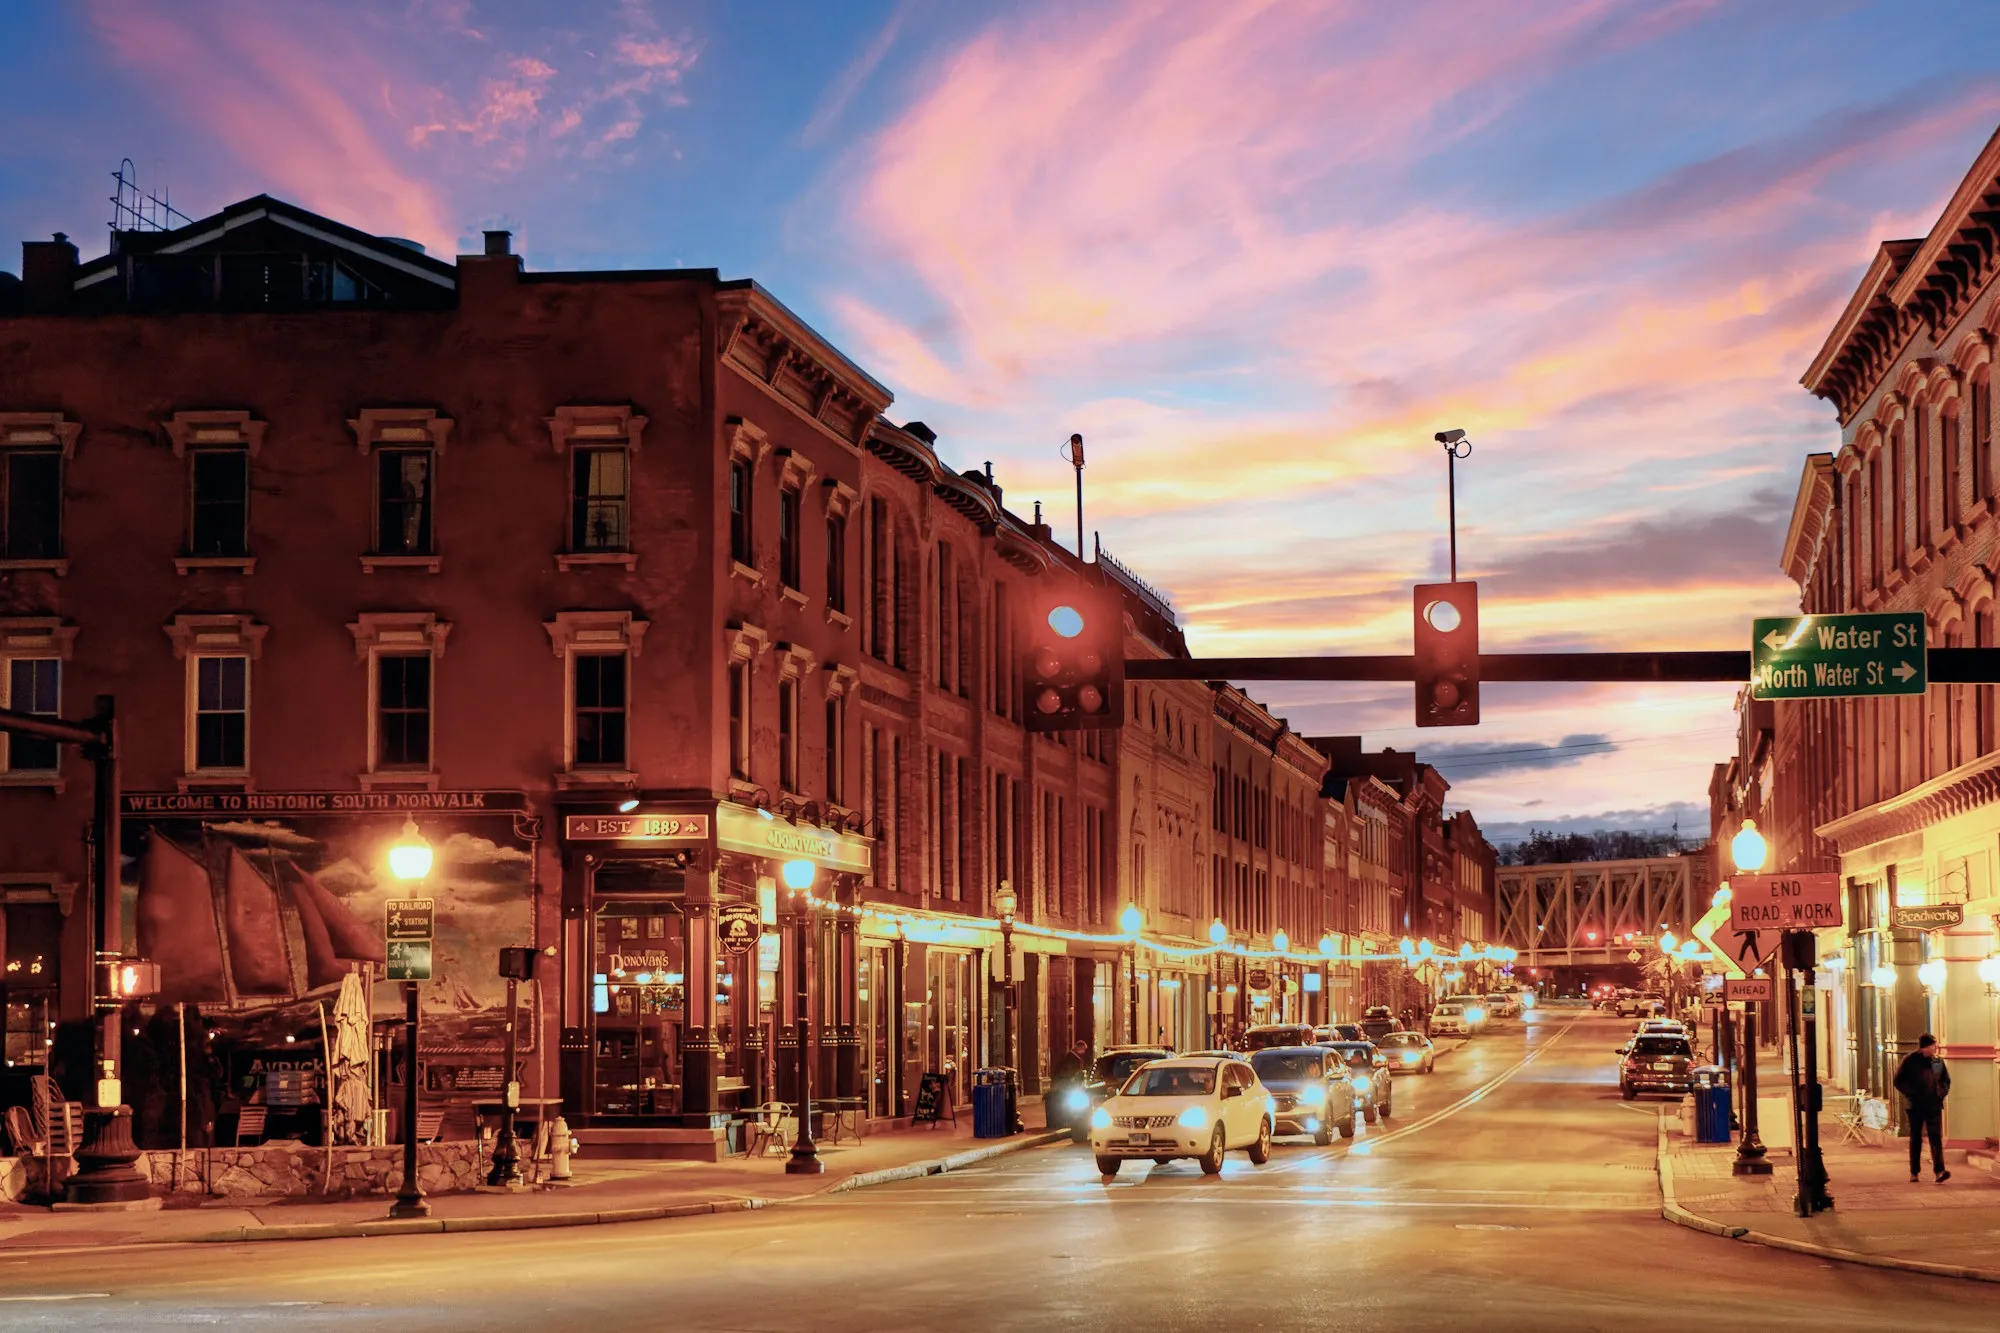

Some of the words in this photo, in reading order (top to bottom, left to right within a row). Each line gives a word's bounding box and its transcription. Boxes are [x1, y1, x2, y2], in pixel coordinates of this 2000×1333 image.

[1816, 625, 1882, 650] Water
[1892, 623, 1918, 648] St
[1760, 664, 1808, 689] North
[1813, 662, 1860, 687] Water
[1866, 660, 1884, 685] St
[129, 796, 214, 810] WELCOME
[220, 796, 241, 809] TO
[247, 795, 326, 810] HISTORIC
[332, 794, 388, 809] SOUTH
[396, 793, 484, 808] NORWALK
[597, 819, 632, 834] EST.
[643, 820, 680, 835] 1889
[1770, 881, 1801, 897] END
[388, 902, 397, 911] TO
[399, 902, 432, 911] RAILROAD
[1741, 905, 1780, 921] ROAD
[1792, 903, 1833, 919] WORK
[404, 917, 429, 926] STATION
[1897, 909, 1960, 924] Beadworks
[1704, 992, 1724, 1004] 25
[1732, 985, 1766, 995] AHEAD
